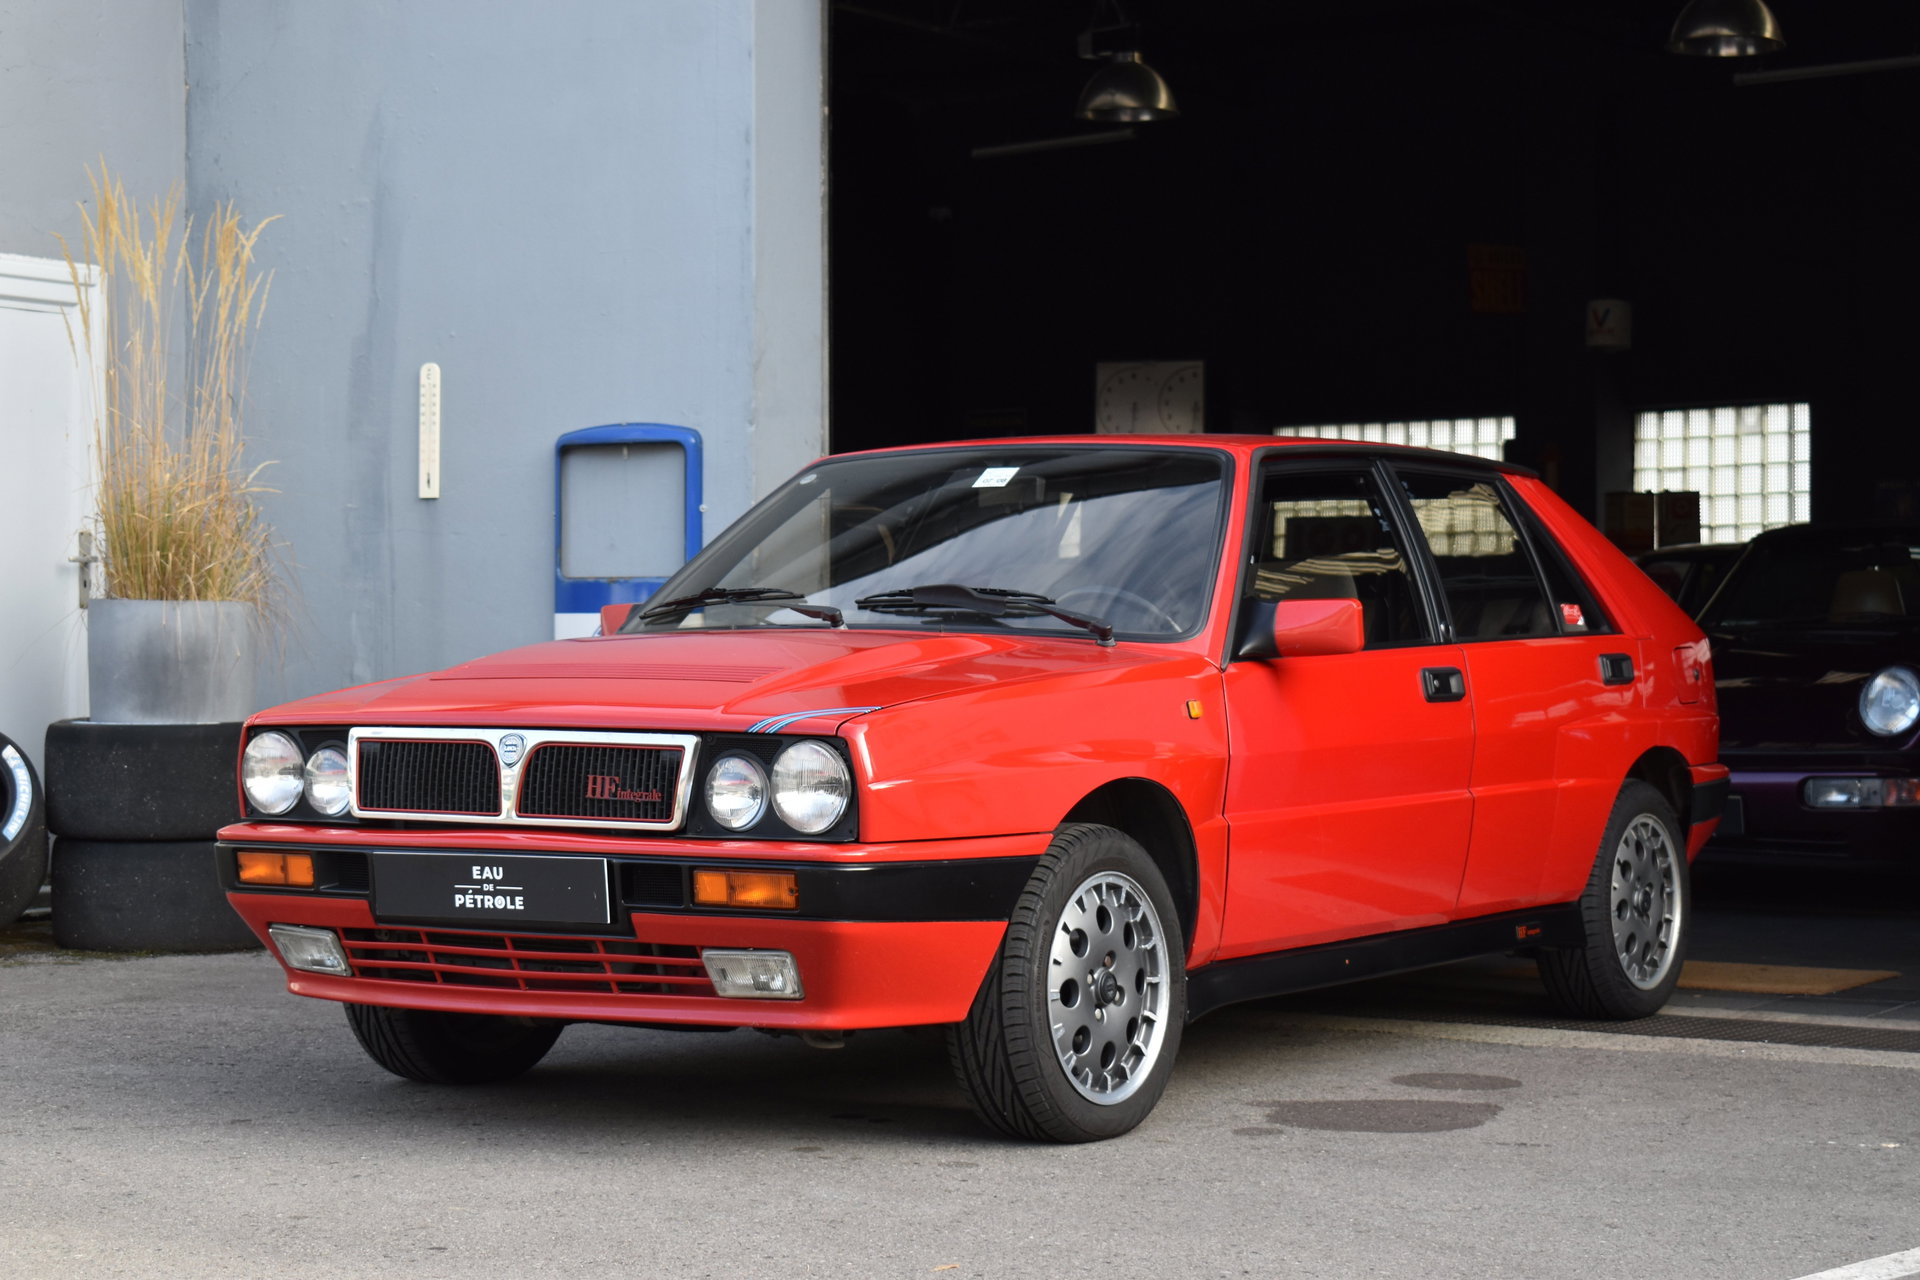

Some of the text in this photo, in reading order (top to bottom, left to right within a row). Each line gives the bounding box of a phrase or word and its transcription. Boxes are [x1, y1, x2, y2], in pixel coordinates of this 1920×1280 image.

[585, 774, 662, 802] HF integrale
[472, 865, 504, 880] EAU
[483, 883, 495, 891] DE
[454, 889, 525, 910] PÉTROLE
